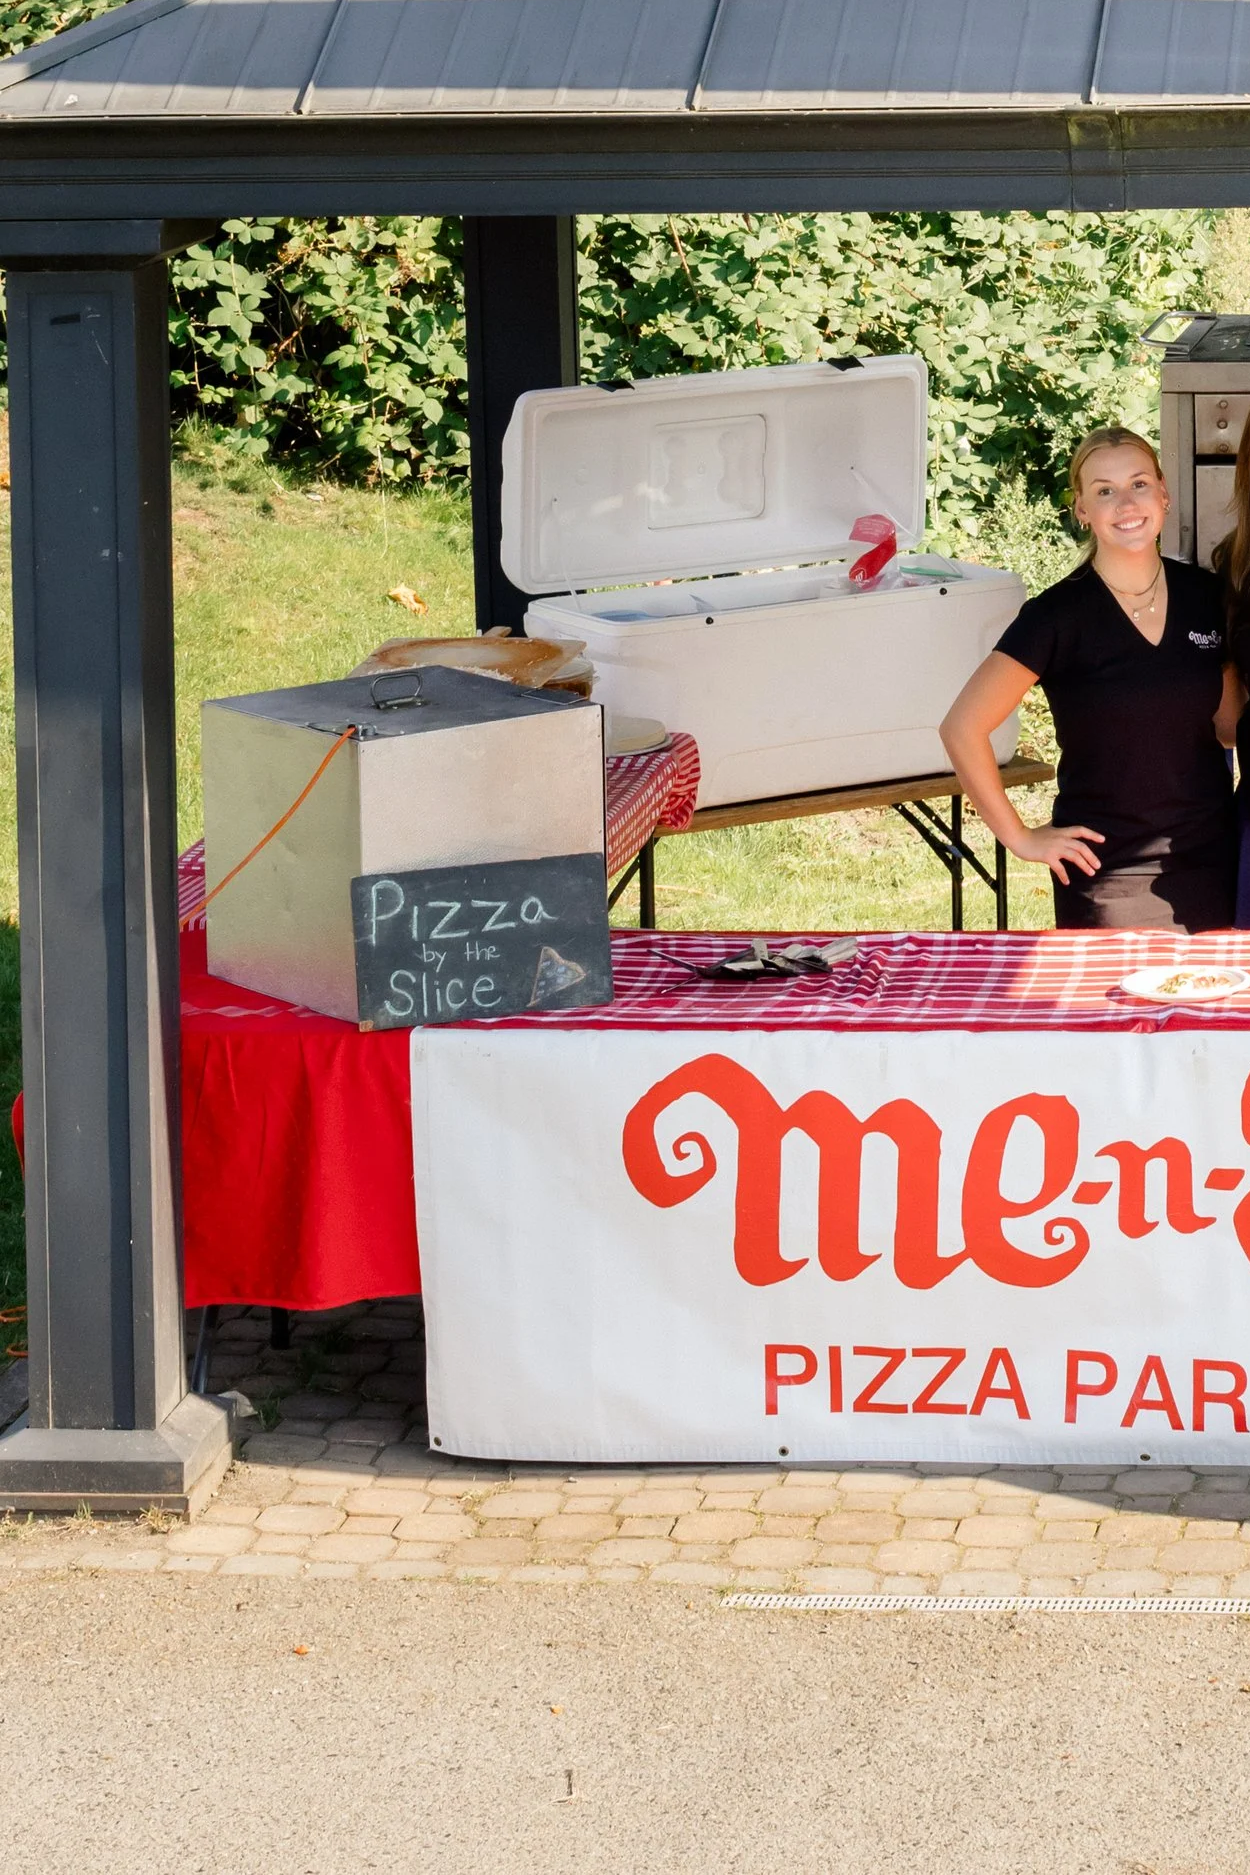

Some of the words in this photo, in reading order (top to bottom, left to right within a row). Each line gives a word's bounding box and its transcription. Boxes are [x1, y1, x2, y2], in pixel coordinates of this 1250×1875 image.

[370, 880, 557, 947] Pizza
[420, 941, 447, 971] by
[464, 941, 501, 962] the
[383, 969, 503, 1018] Slice
[765, 1343, 1030, 1420] PIZZA
